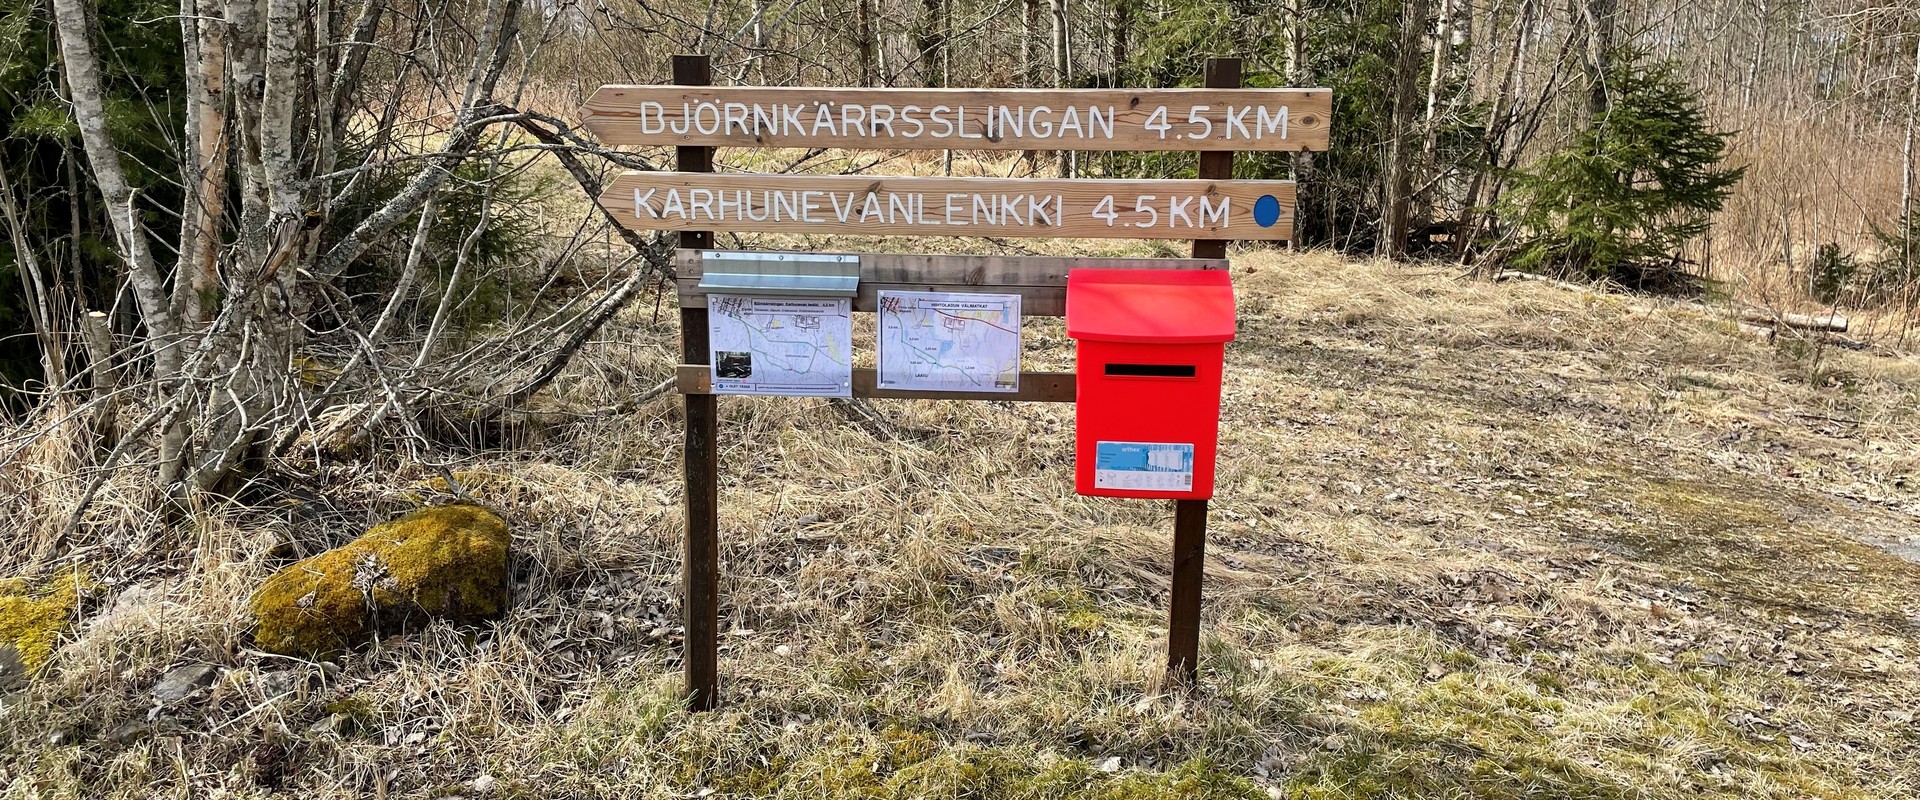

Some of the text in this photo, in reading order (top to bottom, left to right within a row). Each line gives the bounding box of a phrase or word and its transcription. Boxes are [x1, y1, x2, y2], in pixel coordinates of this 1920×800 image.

[640, 98, 1290, 141] BJÖRNKÄRRSSLINGAN 4.5 KM
[633, 187, 1231, 230] KARHUNEVANLENKKI 4.5 KM
